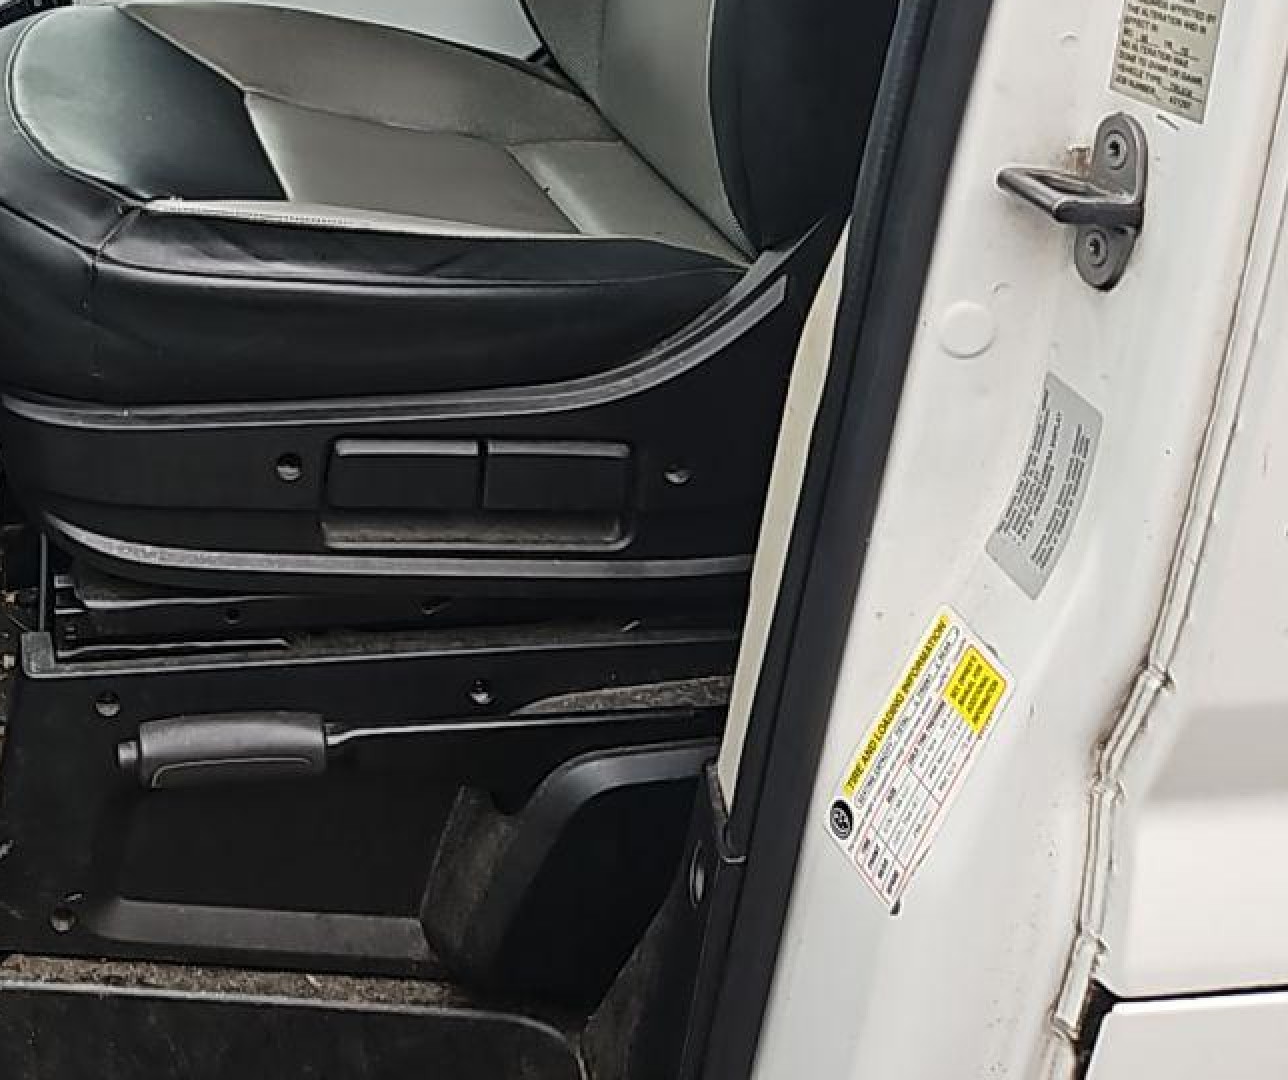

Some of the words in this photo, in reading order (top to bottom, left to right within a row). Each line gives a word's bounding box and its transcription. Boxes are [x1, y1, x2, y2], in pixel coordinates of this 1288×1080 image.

[847, 761, 865, 790] TIRE
[860, 737, 879, 766] AND
[873, 691, 905, 743] LOADING
[902, 619, 946, 694] INFORMATION
